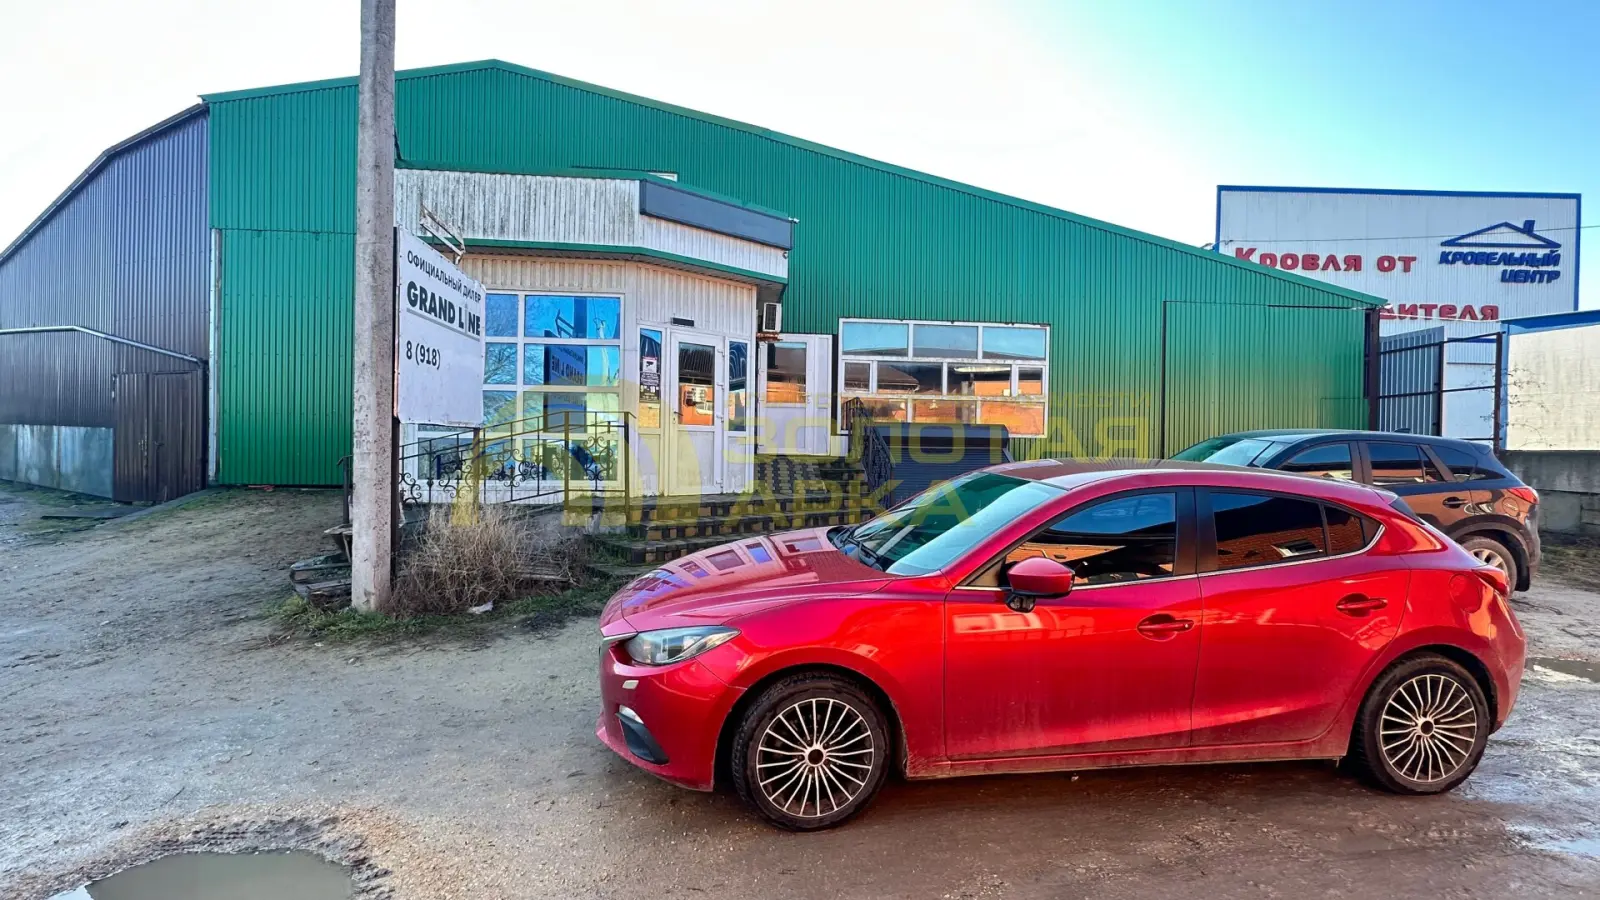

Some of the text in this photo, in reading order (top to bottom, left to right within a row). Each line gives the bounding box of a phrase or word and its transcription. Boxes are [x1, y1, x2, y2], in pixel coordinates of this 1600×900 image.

[1439, 249, 1561, 268] КРОВЕЛЬНЫЙ
[407, 250, 482, 304] ОФИЦИАЛЬНЫЙ ДИЛЕР
[1500, 269, 1561, 284] ЦЕНТР
[406, 280, 456, 324] GRAND
[406, 340, 441, 370] 8 (918)
